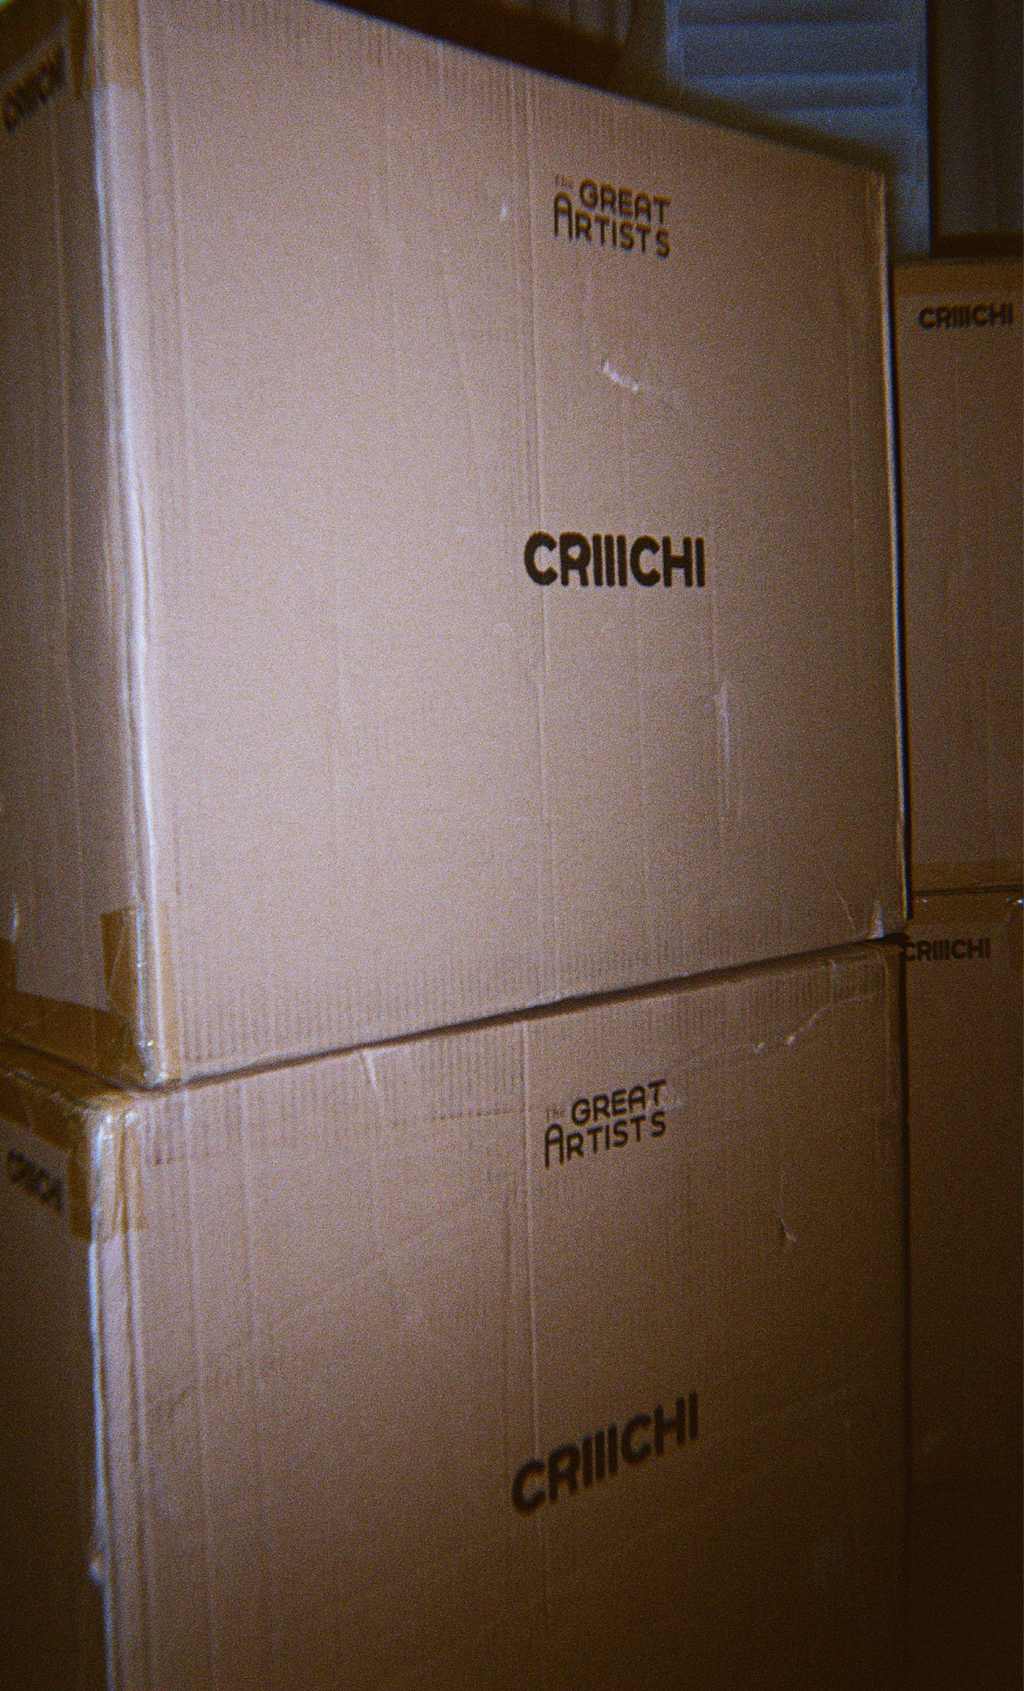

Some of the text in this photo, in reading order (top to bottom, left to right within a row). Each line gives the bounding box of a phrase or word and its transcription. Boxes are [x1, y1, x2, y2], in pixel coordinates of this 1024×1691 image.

[554, 191, 671, 258] ARTISTS
[579, 178, 671, 225] GREAT
[918, 300, 1014, 330] CRIIICHI
[524, 531, 706, 587] CRIIICHI
[572, 1079, 667, 1126] GREAT
[545, 1110, 666, 1169] ARTISTS
[511, 1391, 699, 1514] CRIIICHI
